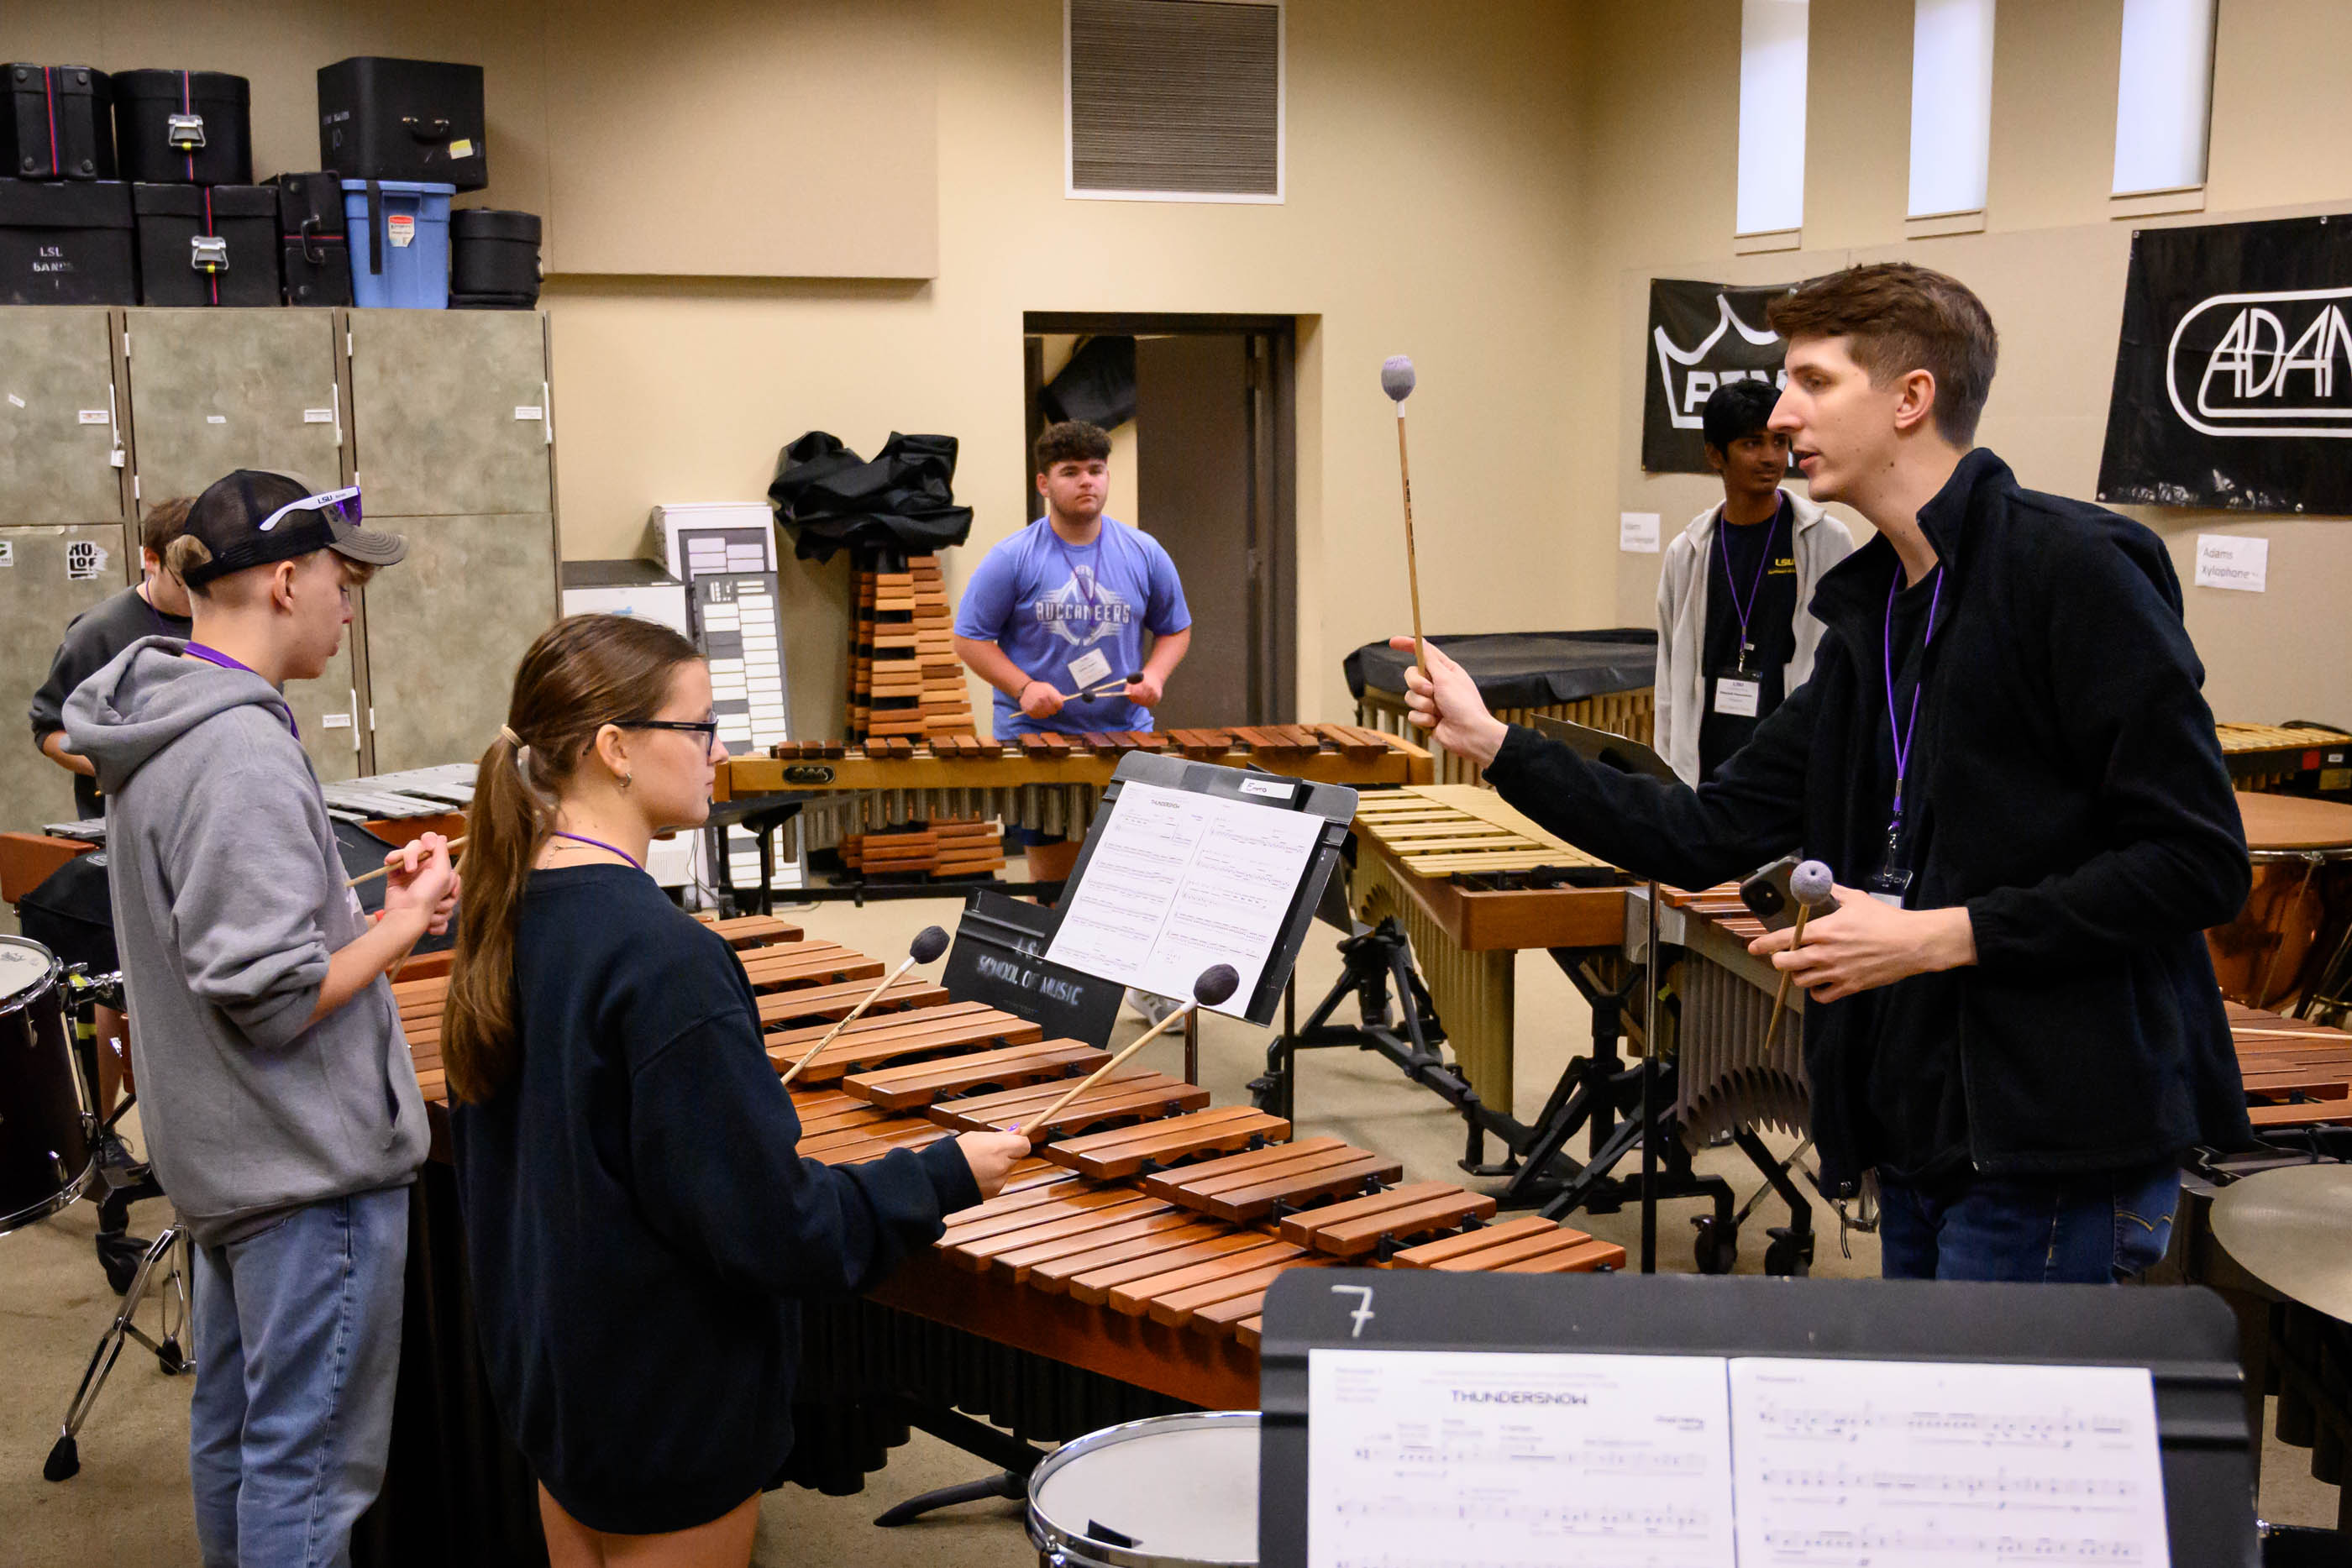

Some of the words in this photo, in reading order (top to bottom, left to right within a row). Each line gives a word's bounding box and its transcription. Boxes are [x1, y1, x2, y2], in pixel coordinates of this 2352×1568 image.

[318, 496, 333, 504] LSU
[1039, 976, 1084, 1006] MUSIC
[1330, 1284, 1375, 1338] 7
[1452, 1389, 1588, 1405] THUNDERSNOW
